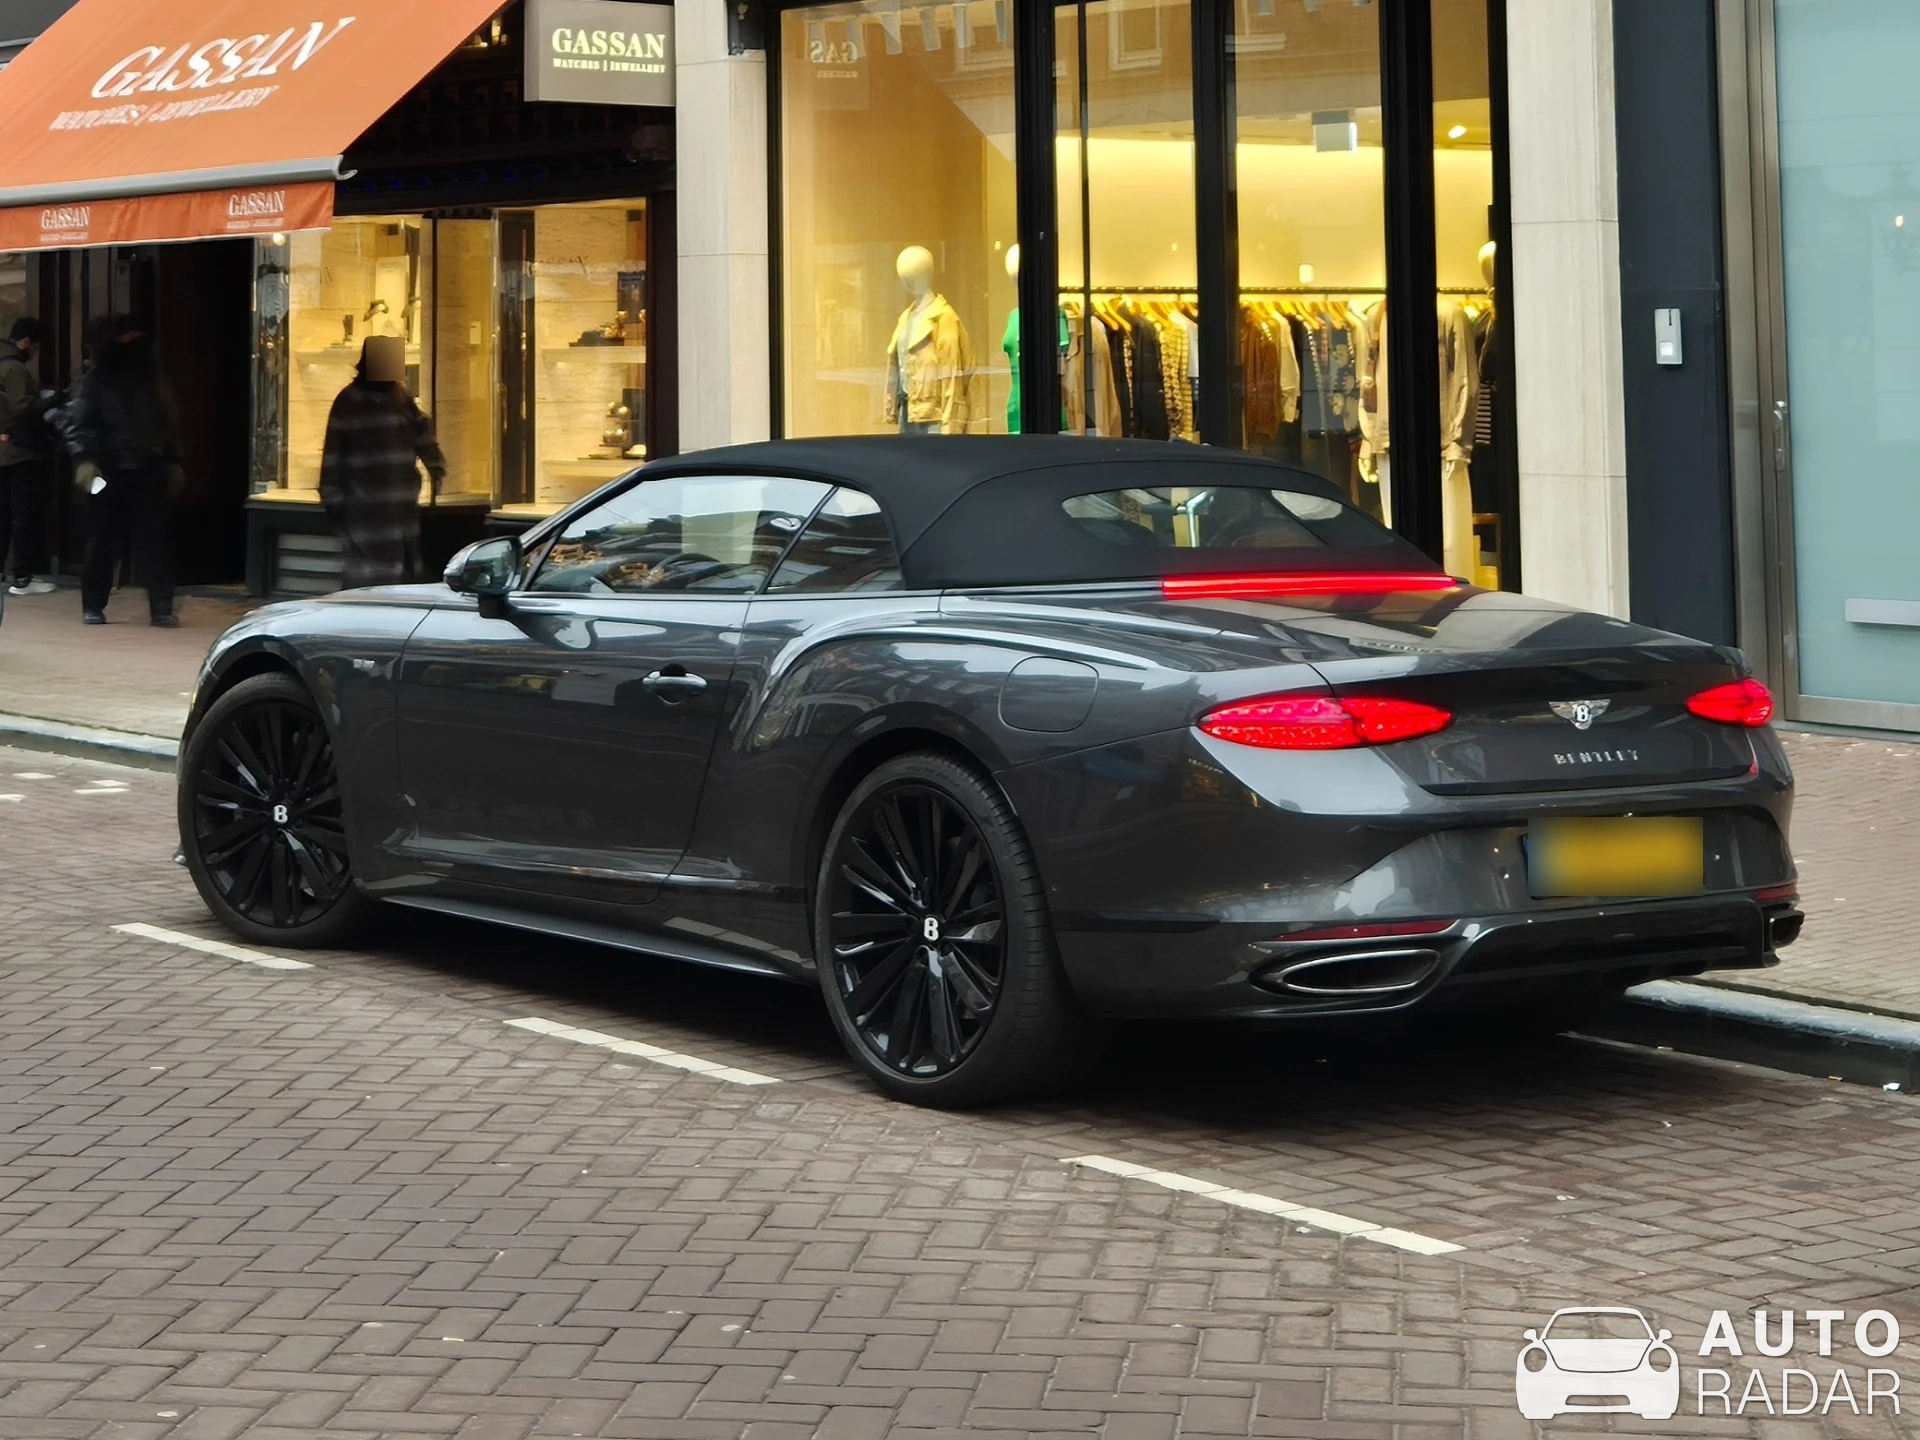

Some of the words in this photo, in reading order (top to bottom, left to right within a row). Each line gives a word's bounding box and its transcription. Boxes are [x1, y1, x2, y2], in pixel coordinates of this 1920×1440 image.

[552, 28, 666, 59] GASSAN
[91, 16, 356, 98] GASSAN
[228, 190, 285, 216] GASSAN
[41, 206, 90, 229] GASSAN
[273, 804, 288, 823] B
[923, 917, 939, 941] B
